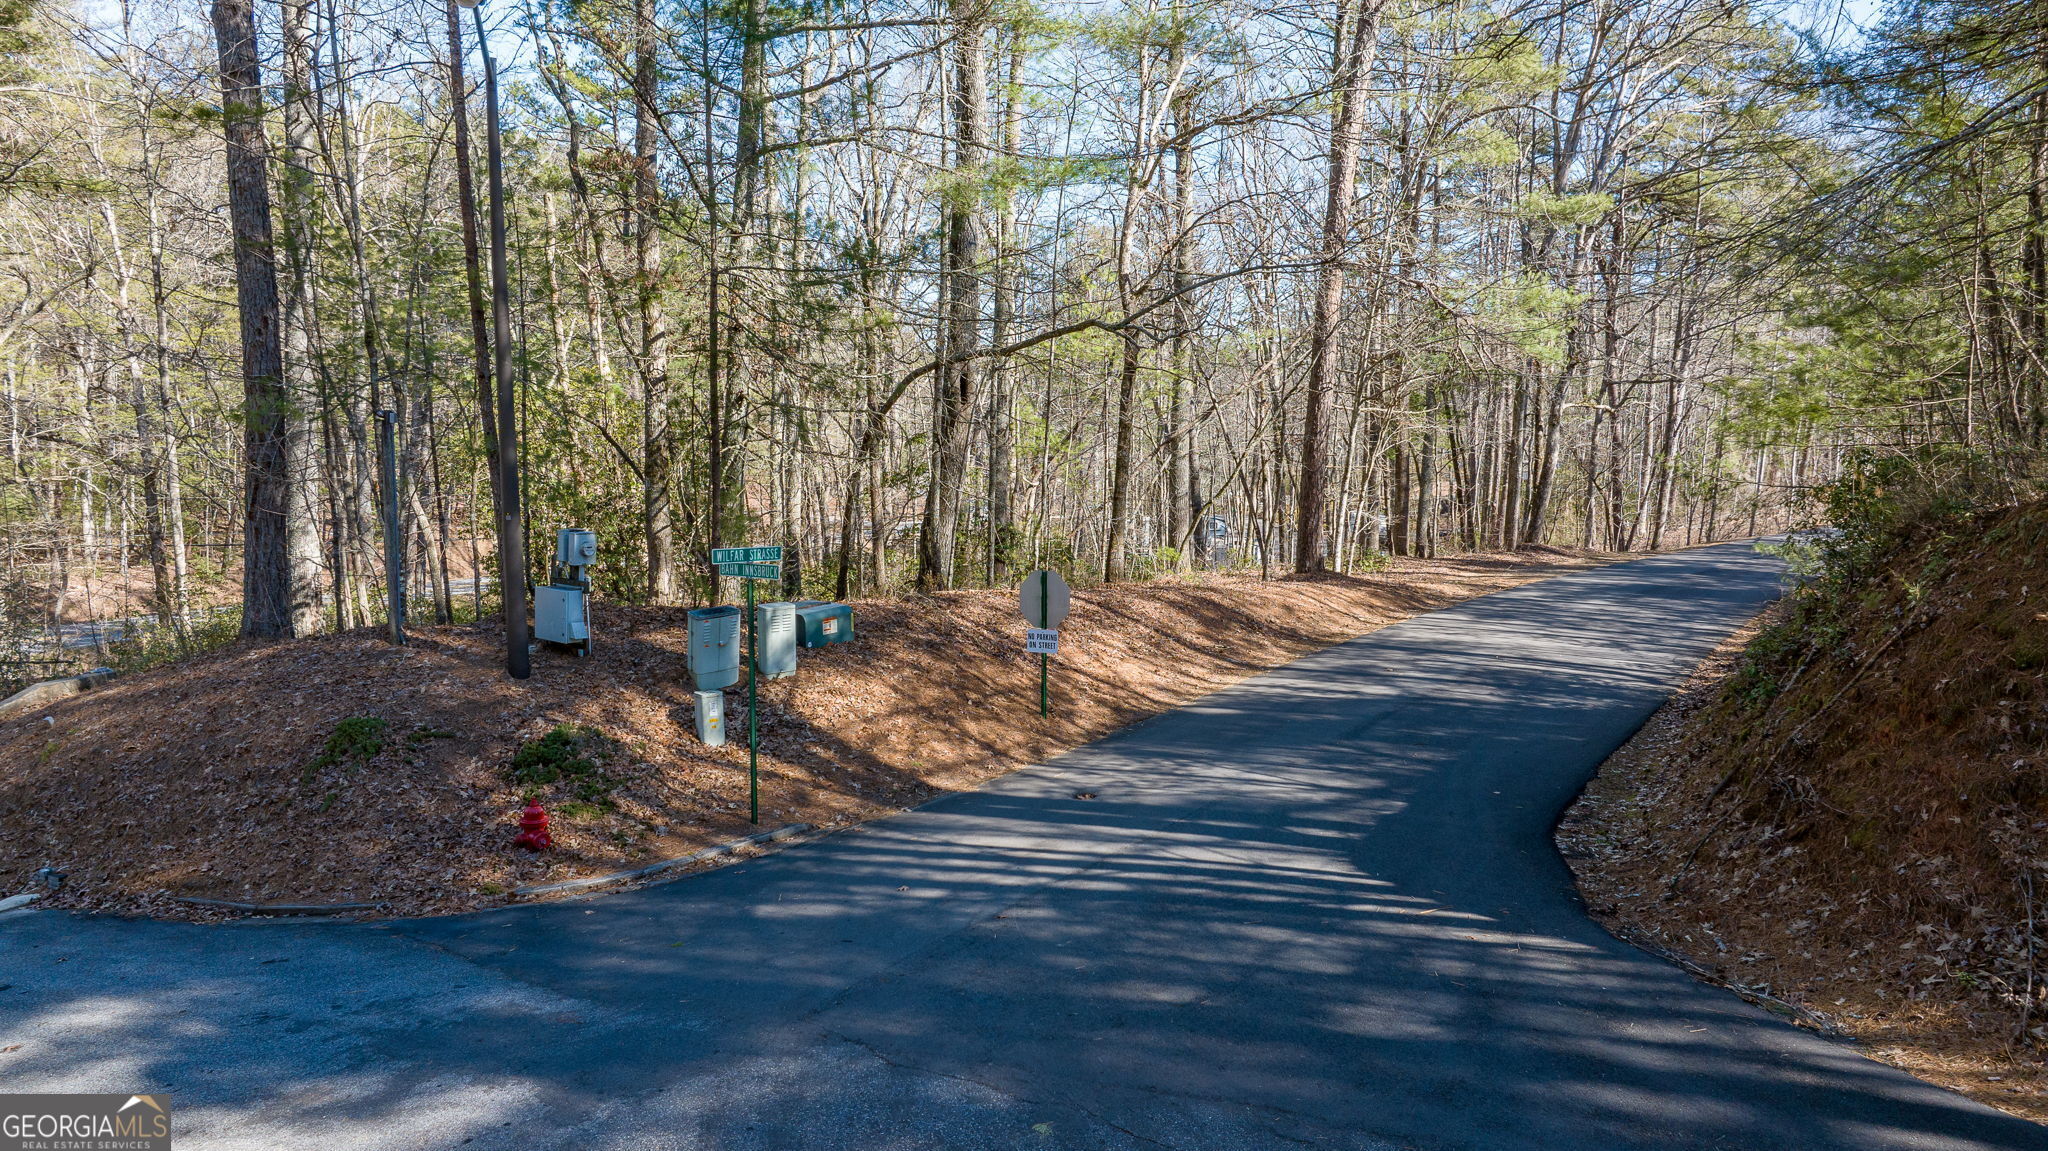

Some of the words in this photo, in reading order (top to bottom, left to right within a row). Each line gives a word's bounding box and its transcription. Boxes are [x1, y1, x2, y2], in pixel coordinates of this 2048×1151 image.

[717, 550, 744, 562] WILFAR
[749, 548, 779, 560] STRASSE
[721, 563, 739, 575] BAHN
[743, 565, 778, 578] INNSBRUCK
